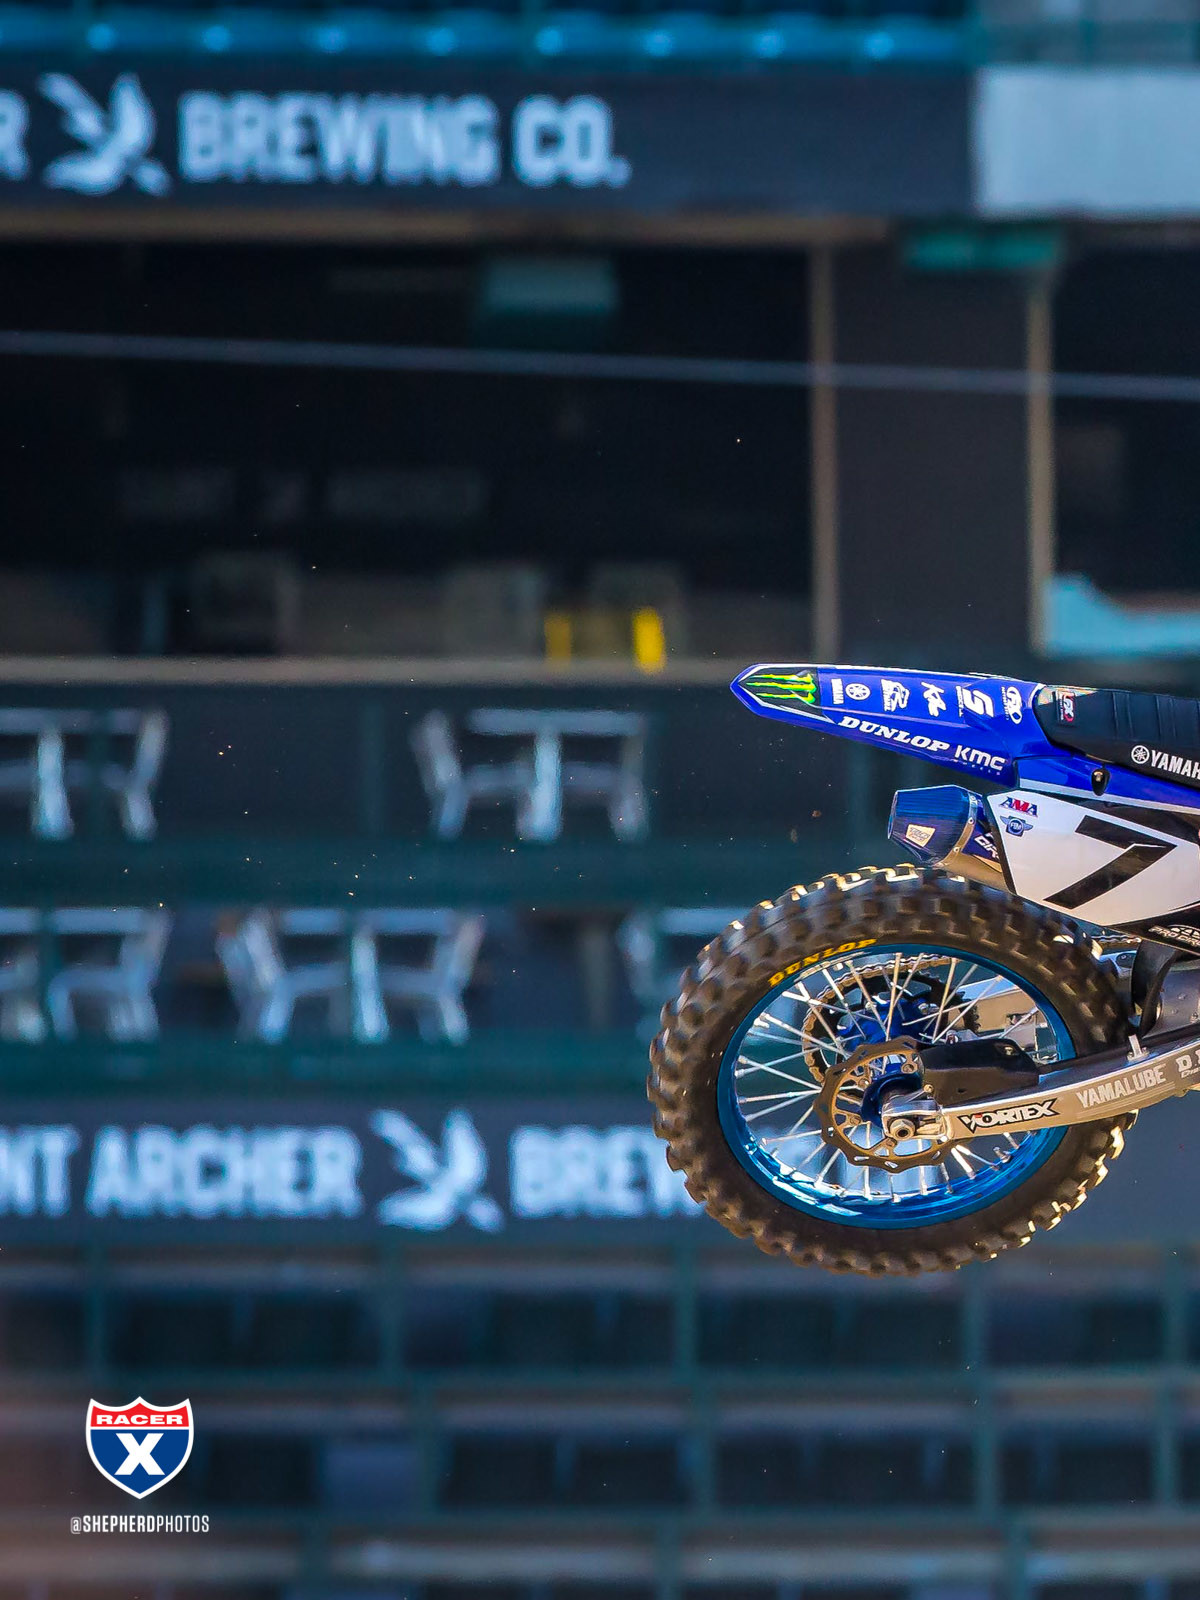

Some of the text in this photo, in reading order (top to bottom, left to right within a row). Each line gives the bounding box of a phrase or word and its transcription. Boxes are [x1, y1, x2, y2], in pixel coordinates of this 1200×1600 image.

[178, 90, 498, 186] BREWING
[513, 93, 632, 187] CO.
[838, 715, 950, 753] DUNLOP
[1000, 796, 1039, 818] AMA
[1043, 814, 1178, 910] 7
[1148, 925, 1179, 939] PRO
[768, 938, 878, 988] DUNLOP
[1075, 1063, 1168, 1109] YAMALUBE
[958, 1099, 1057, 1132] VORTEX
[86, 1125, 362, 1218] ARCHER
